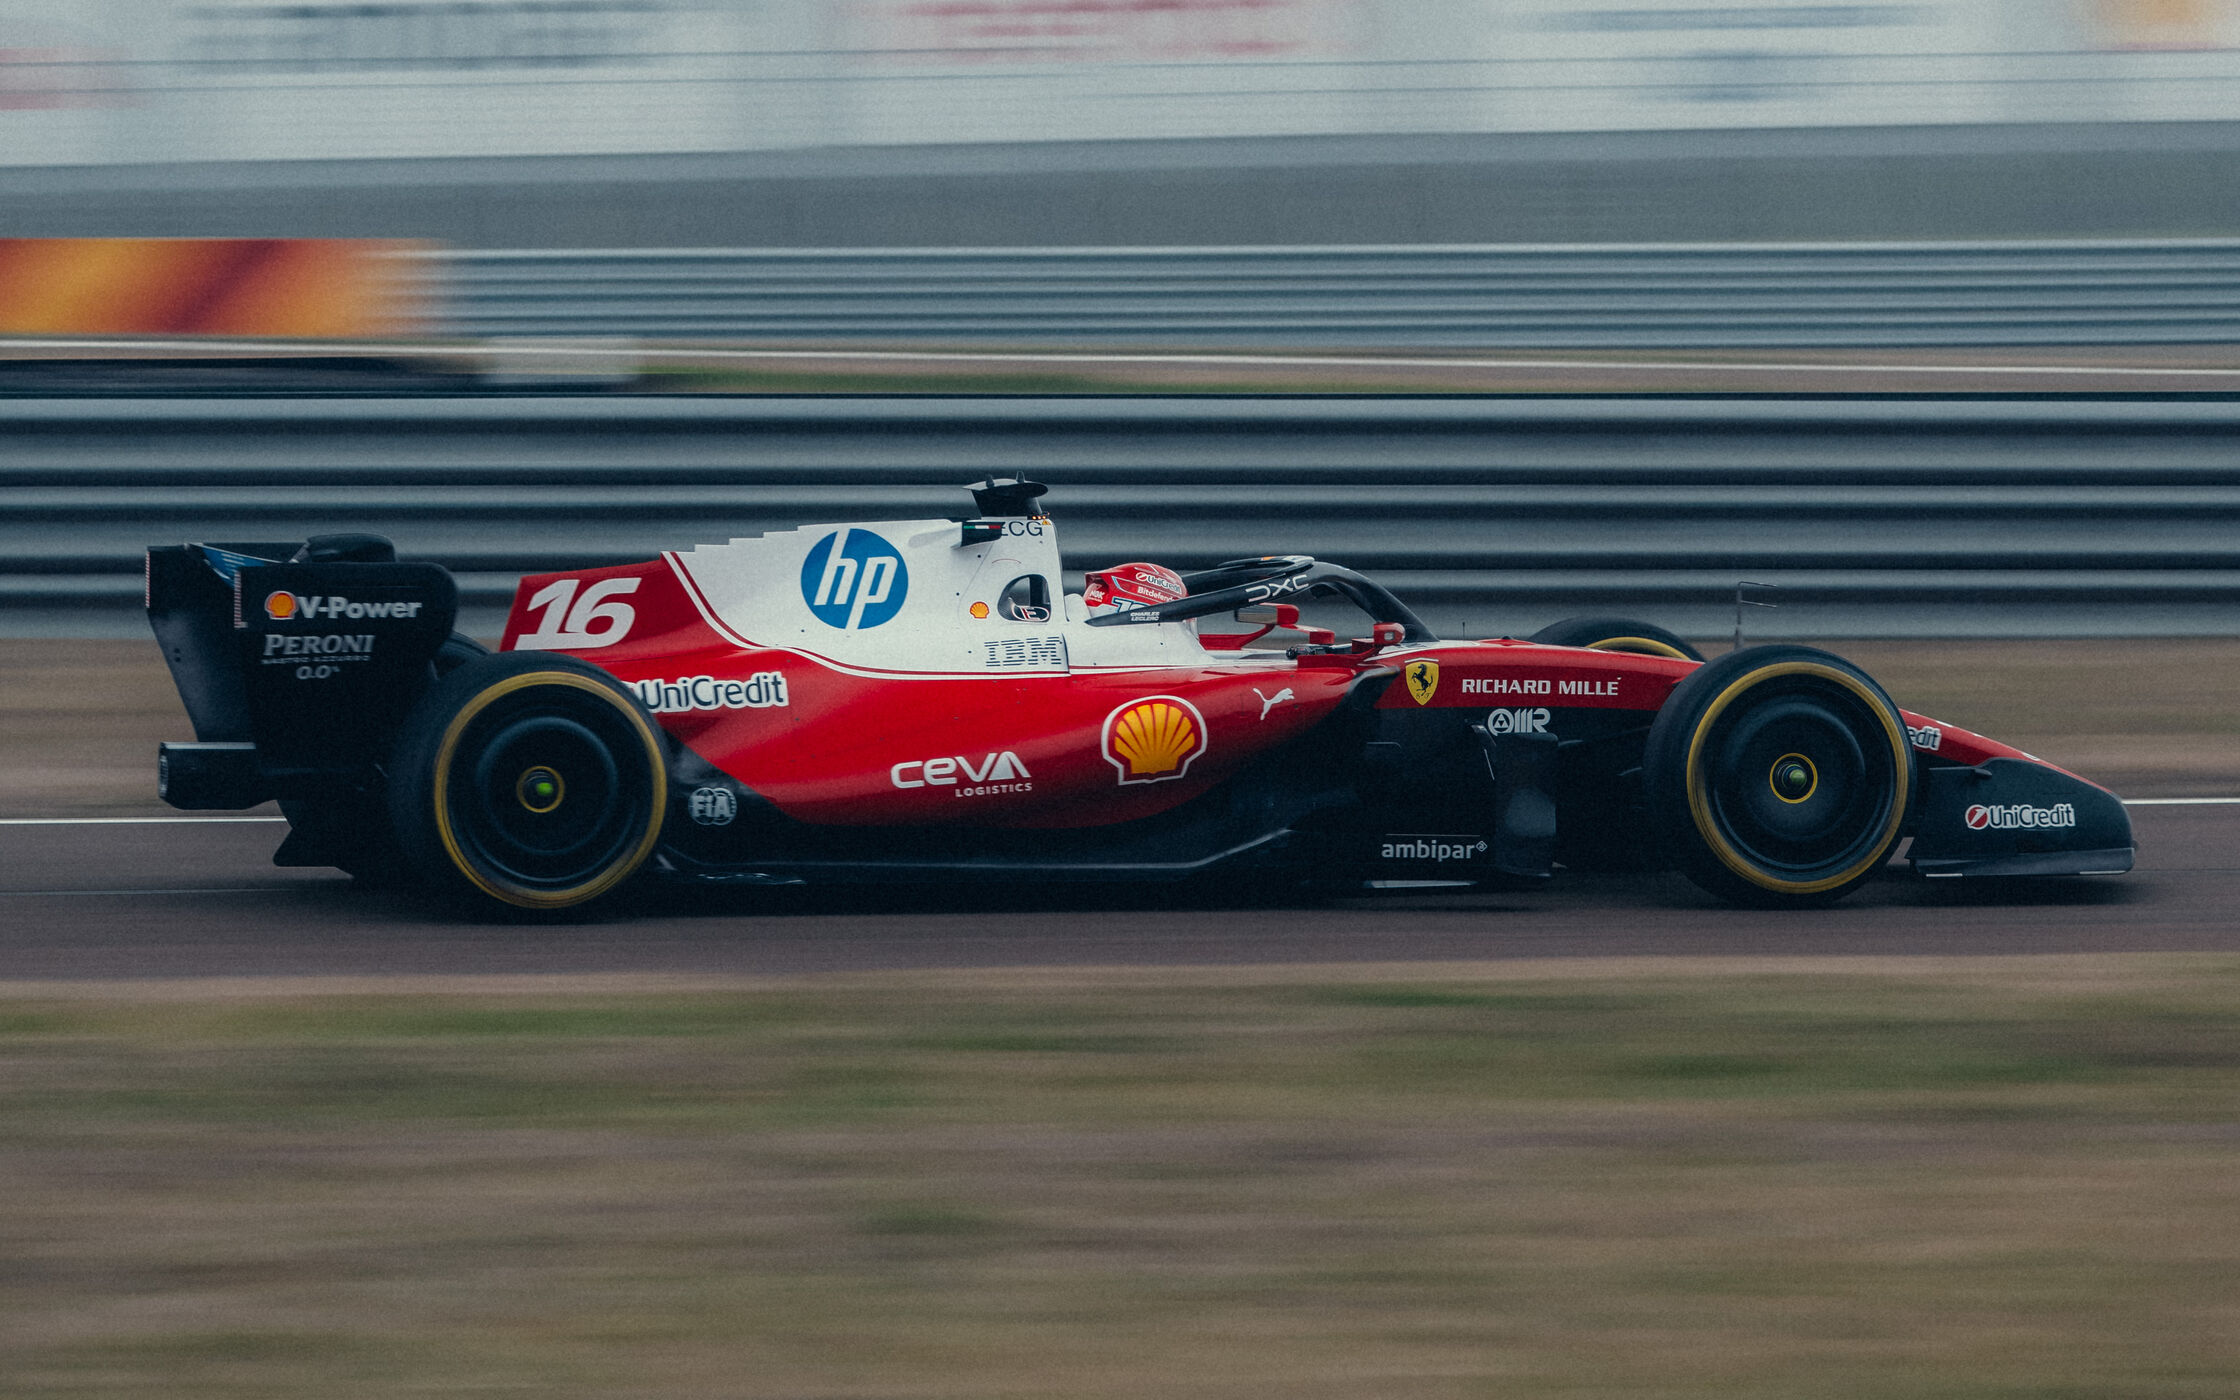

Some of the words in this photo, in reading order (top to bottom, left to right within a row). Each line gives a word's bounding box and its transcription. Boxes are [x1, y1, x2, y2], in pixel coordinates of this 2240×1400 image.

[813, 528, 898, 629] hp
[1245, 575, 1309, 602] DXC
[296, 596, 422, 619] V-Power
[514, 577, 642, 651] 16
[263, 634, 376, 655] PERONI
[984, 636, 1062, 667] IBM
[640, 675, 784, 709] UniCredit
[1462, 679, 1551, 694] RICHARD
[1558, 680, 1619, 696] MILLE
[955, 782, 1032, 797] LOGISTICS
[692, 794, 732, 819] FIA
[1988, 804, 2075, 827] UniCredit
[1381, 839, 1475, 863] ambipar
